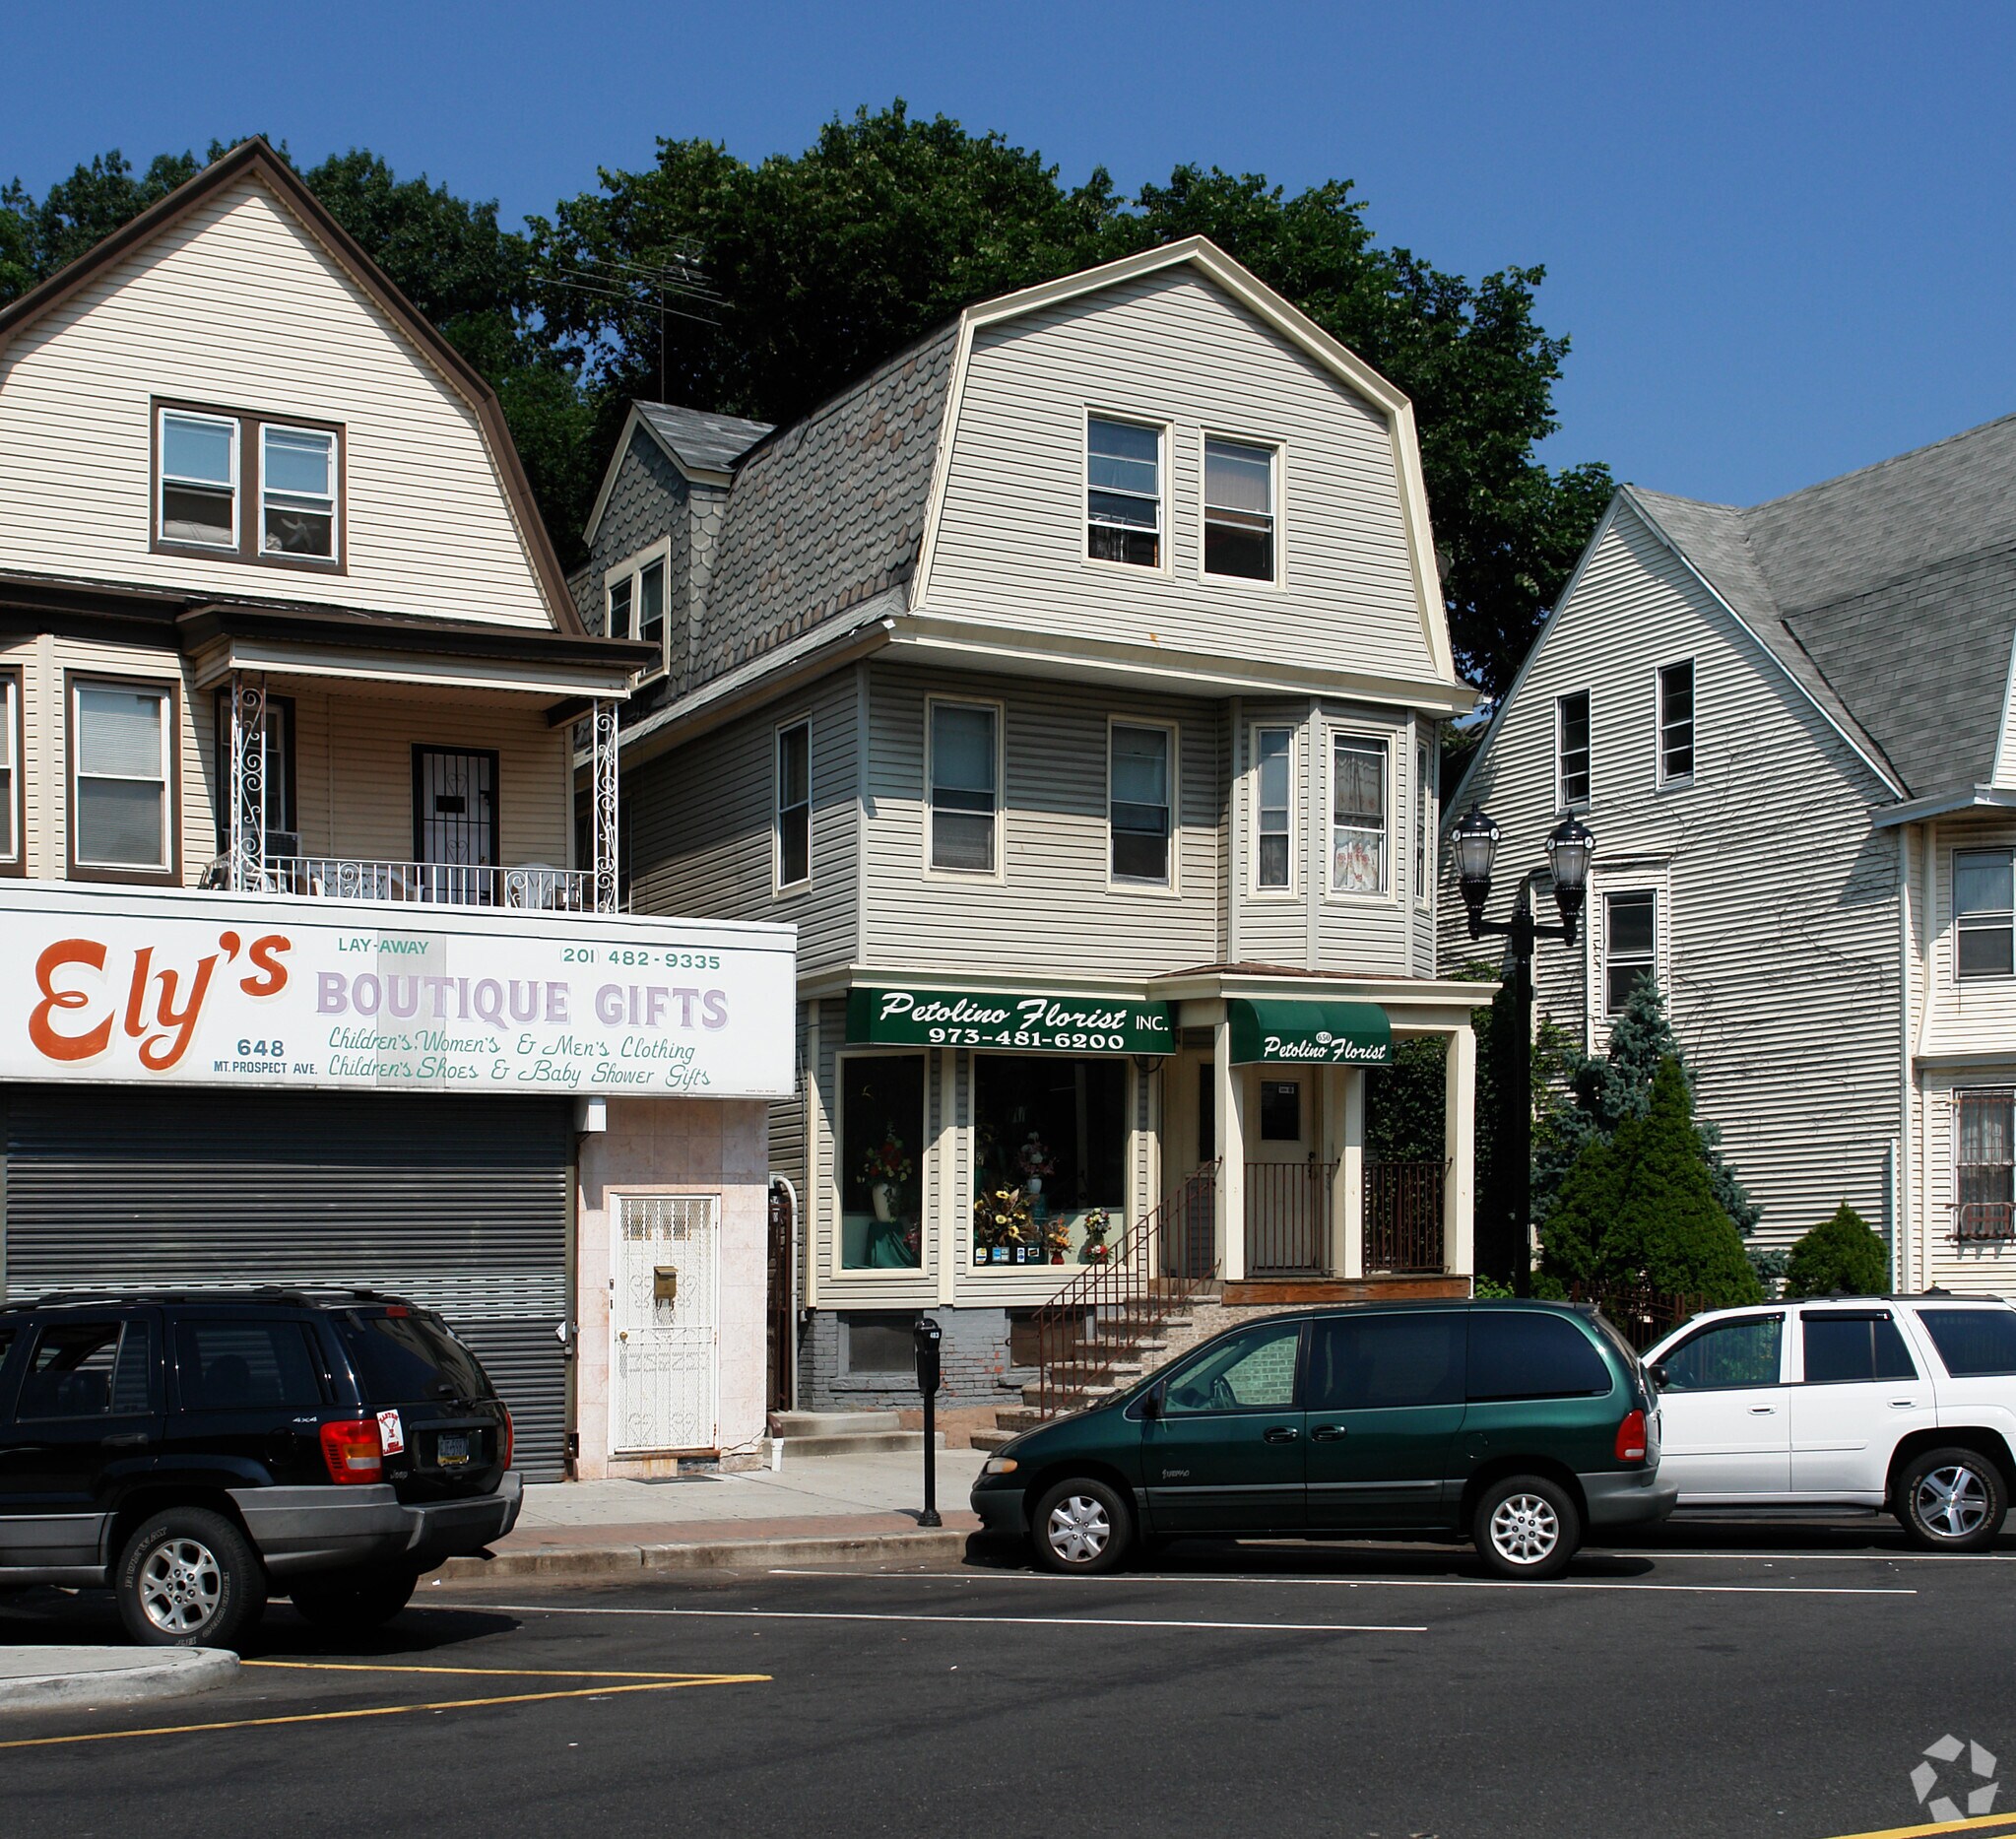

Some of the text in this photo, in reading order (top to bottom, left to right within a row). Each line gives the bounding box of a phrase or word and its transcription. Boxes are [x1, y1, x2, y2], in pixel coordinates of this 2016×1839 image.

[339, 938, 428, 954] LAY-AWAY
[29, 931, 292, 1071] Ely's
[315, 971, 729, 1030] BOUTIQUE GIFTS
[879, 992, 1169, 1031] Petolino Florist INC.
[237, 1038, 285, 1058] 648
[415, 1030, 500, 1053] Women's
[516, 1033, 537, 1054] &
[542, 1035, 610, 1057] Men's
[620, 1036, 695, 1065] Clothing
[929, 1028, 1125, 1050] 973-481-6200
[1264, 1036, 1387, 1062] Petolino Florist
[1317, 1033, 1331, 1042] 650
[214, 1061, 317, 1075] MT. PROSPECT AVE.
[329, 1054, 711, 1090] Children's Shoes & Baby Shower Gifts
